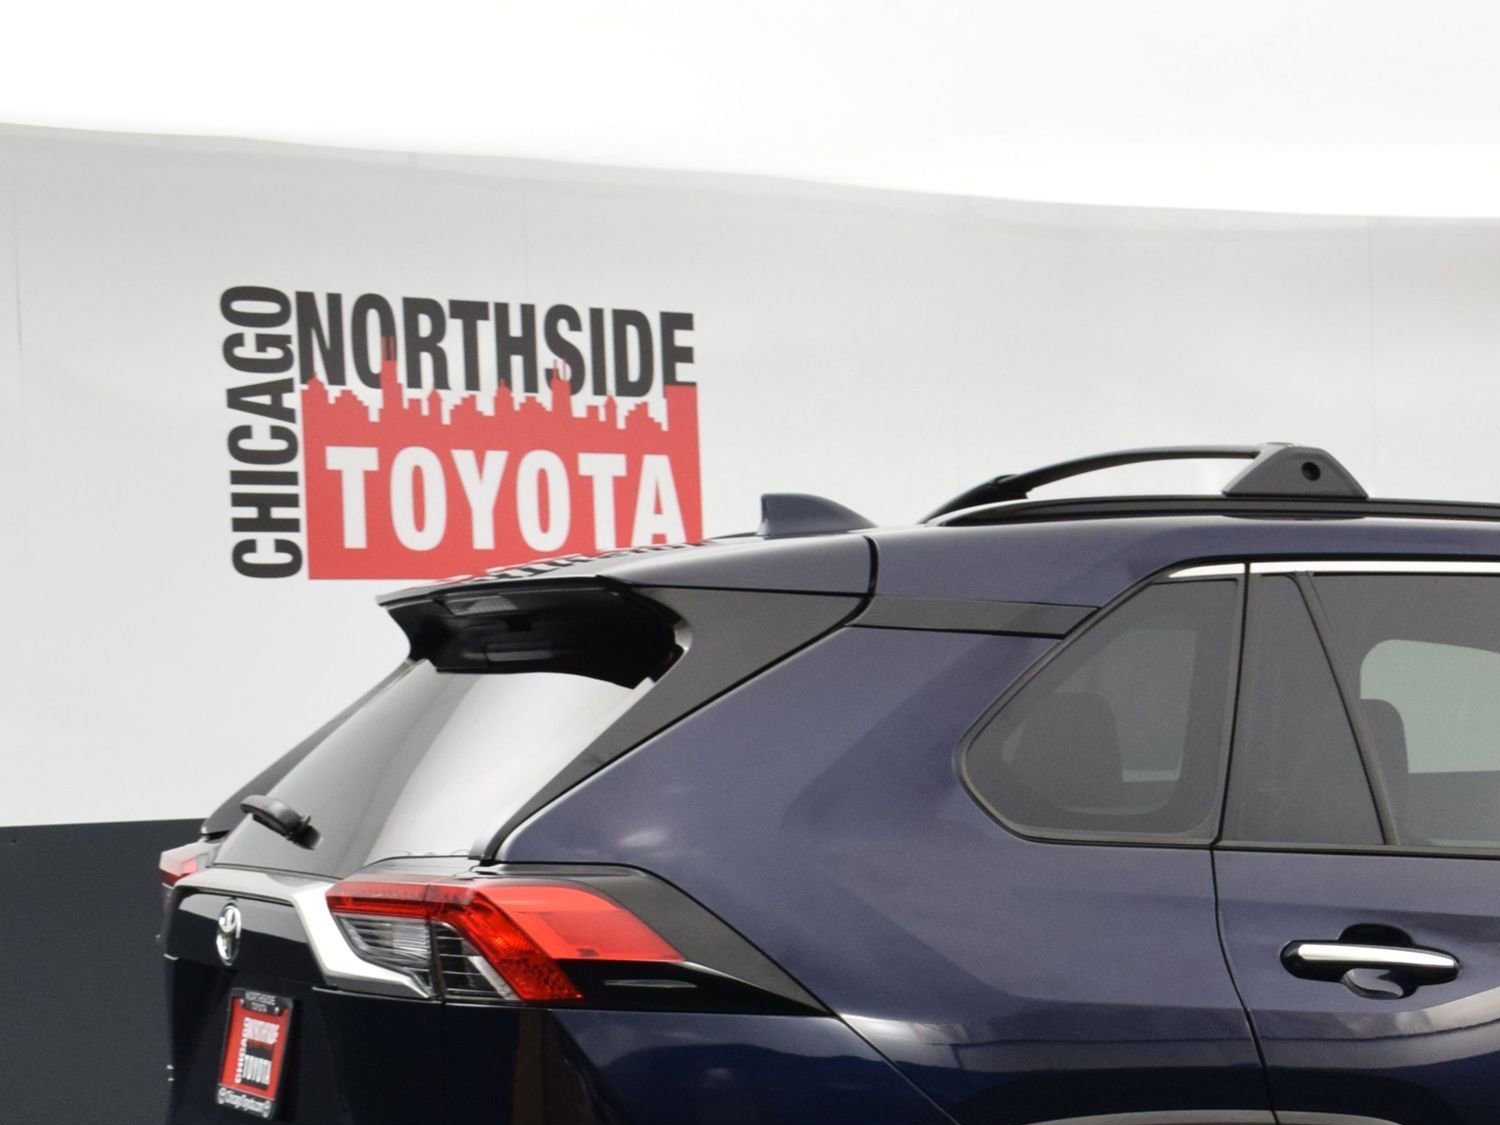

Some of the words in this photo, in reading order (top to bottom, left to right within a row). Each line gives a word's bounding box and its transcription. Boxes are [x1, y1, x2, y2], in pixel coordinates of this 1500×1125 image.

[295, 290, 697, 399] NORTHSIDE
[220, 285, 303, 579] CHICAGO
[325, 446, 687, 552] TOYOTA
